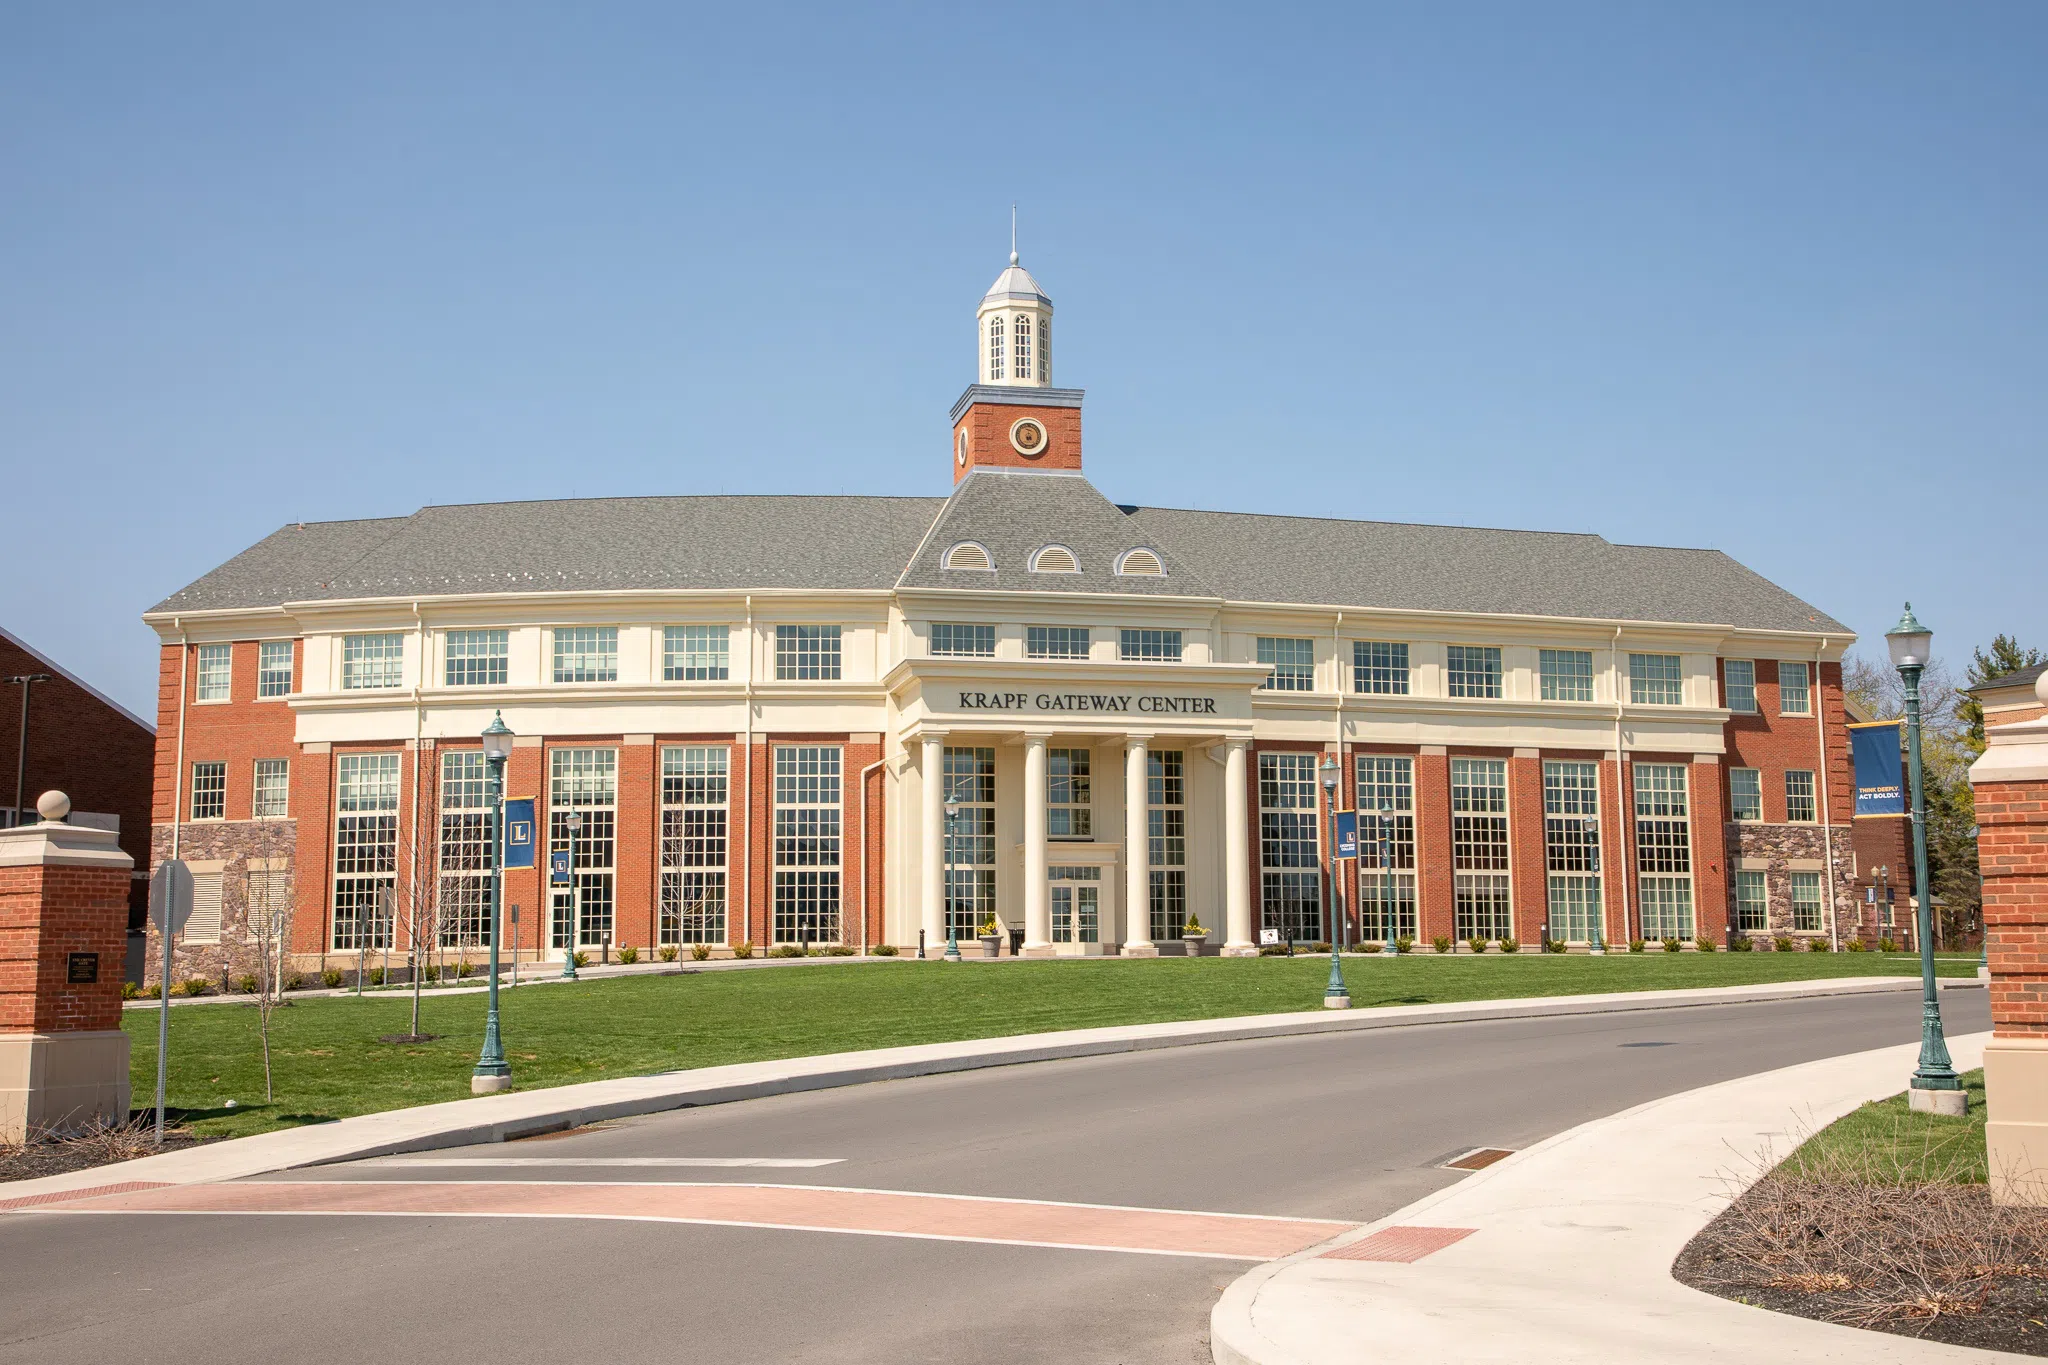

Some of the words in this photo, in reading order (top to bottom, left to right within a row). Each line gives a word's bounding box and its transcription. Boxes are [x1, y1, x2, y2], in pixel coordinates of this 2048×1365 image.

[959, 692, 1028, 709] KRAPF
[1035, 694, 1132, 712] GATEWAY
[1138, 696, 1217, 713] CENTER
[514, 825, 526, 840] L
[558, 862, 564, 870] L
